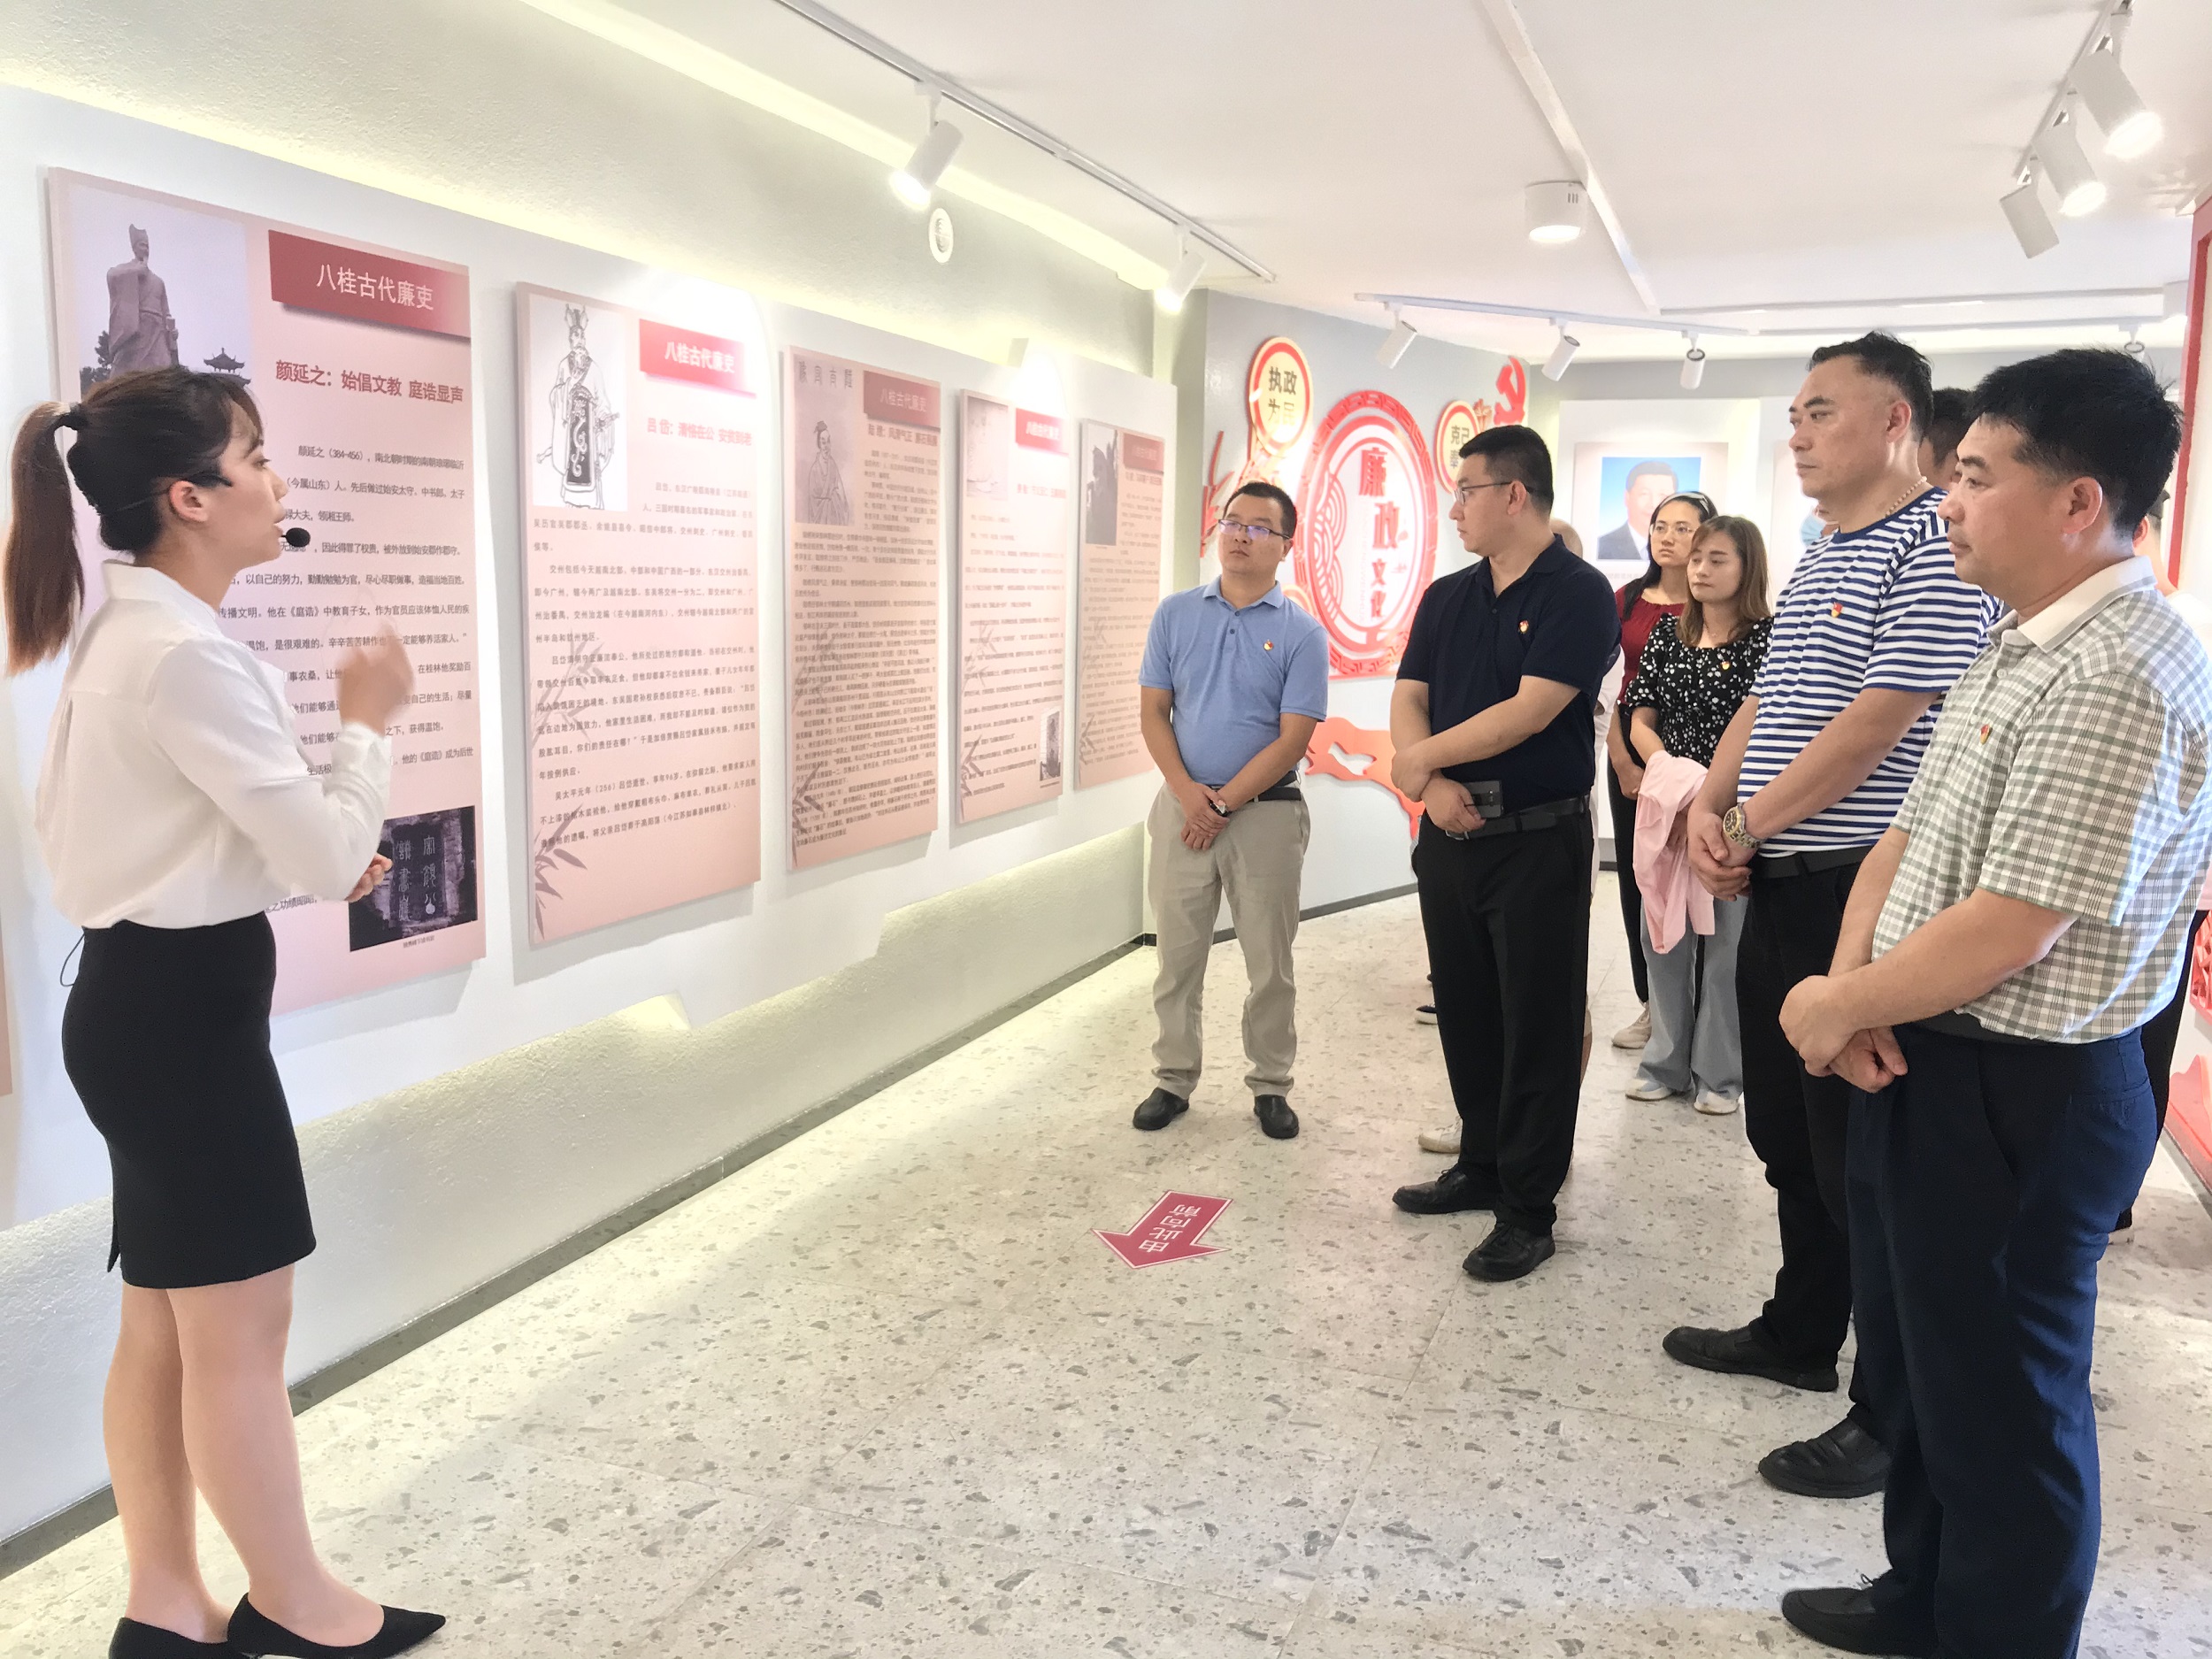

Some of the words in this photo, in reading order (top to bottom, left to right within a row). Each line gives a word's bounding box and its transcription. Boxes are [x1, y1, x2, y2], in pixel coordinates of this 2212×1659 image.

[317, 264, 434, 311] 八桂古代廉吏
[664, 341, 736, 374] 八桂古代廉吏
[275, 359, 403, 397] 颜延之：始倡文教
[409, 379, 465, 405] 庭诰显声
[1268, 365, 1297, 396] 执政
[1450, 425, 1470, 445] 克己
[1138, 1203, 1202, 1253] 由此向前
